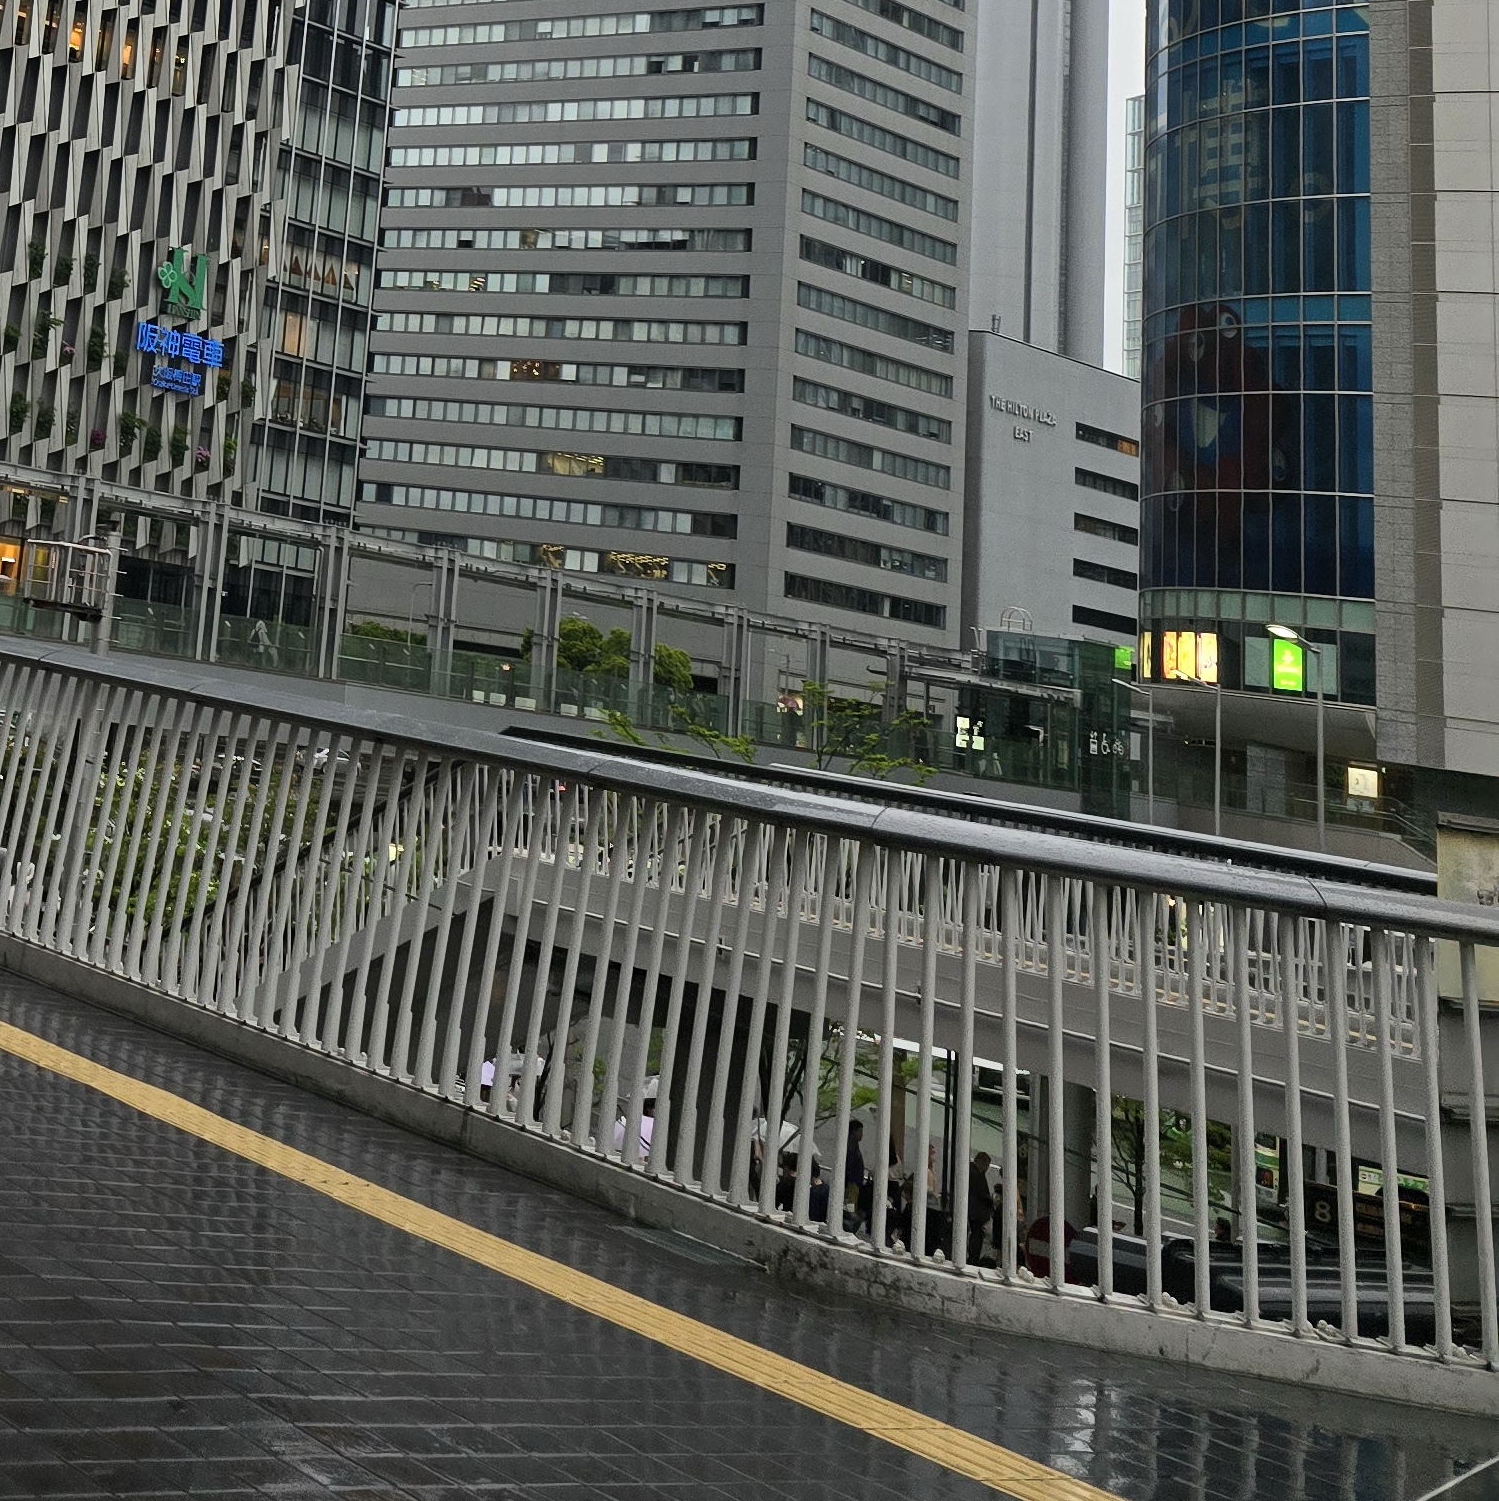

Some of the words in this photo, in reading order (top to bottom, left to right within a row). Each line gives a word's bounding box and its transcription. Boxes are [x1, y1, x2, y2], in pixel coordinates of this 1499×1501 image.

[136, 321, 225, 368] 阪神電車
[991, 396, 1006, 411] THE
[1008, 401, 1033, 419] HILTON
[1035, 409, 1056, 426] PLAZA
[1015, 426, 1033, 441] EAST
